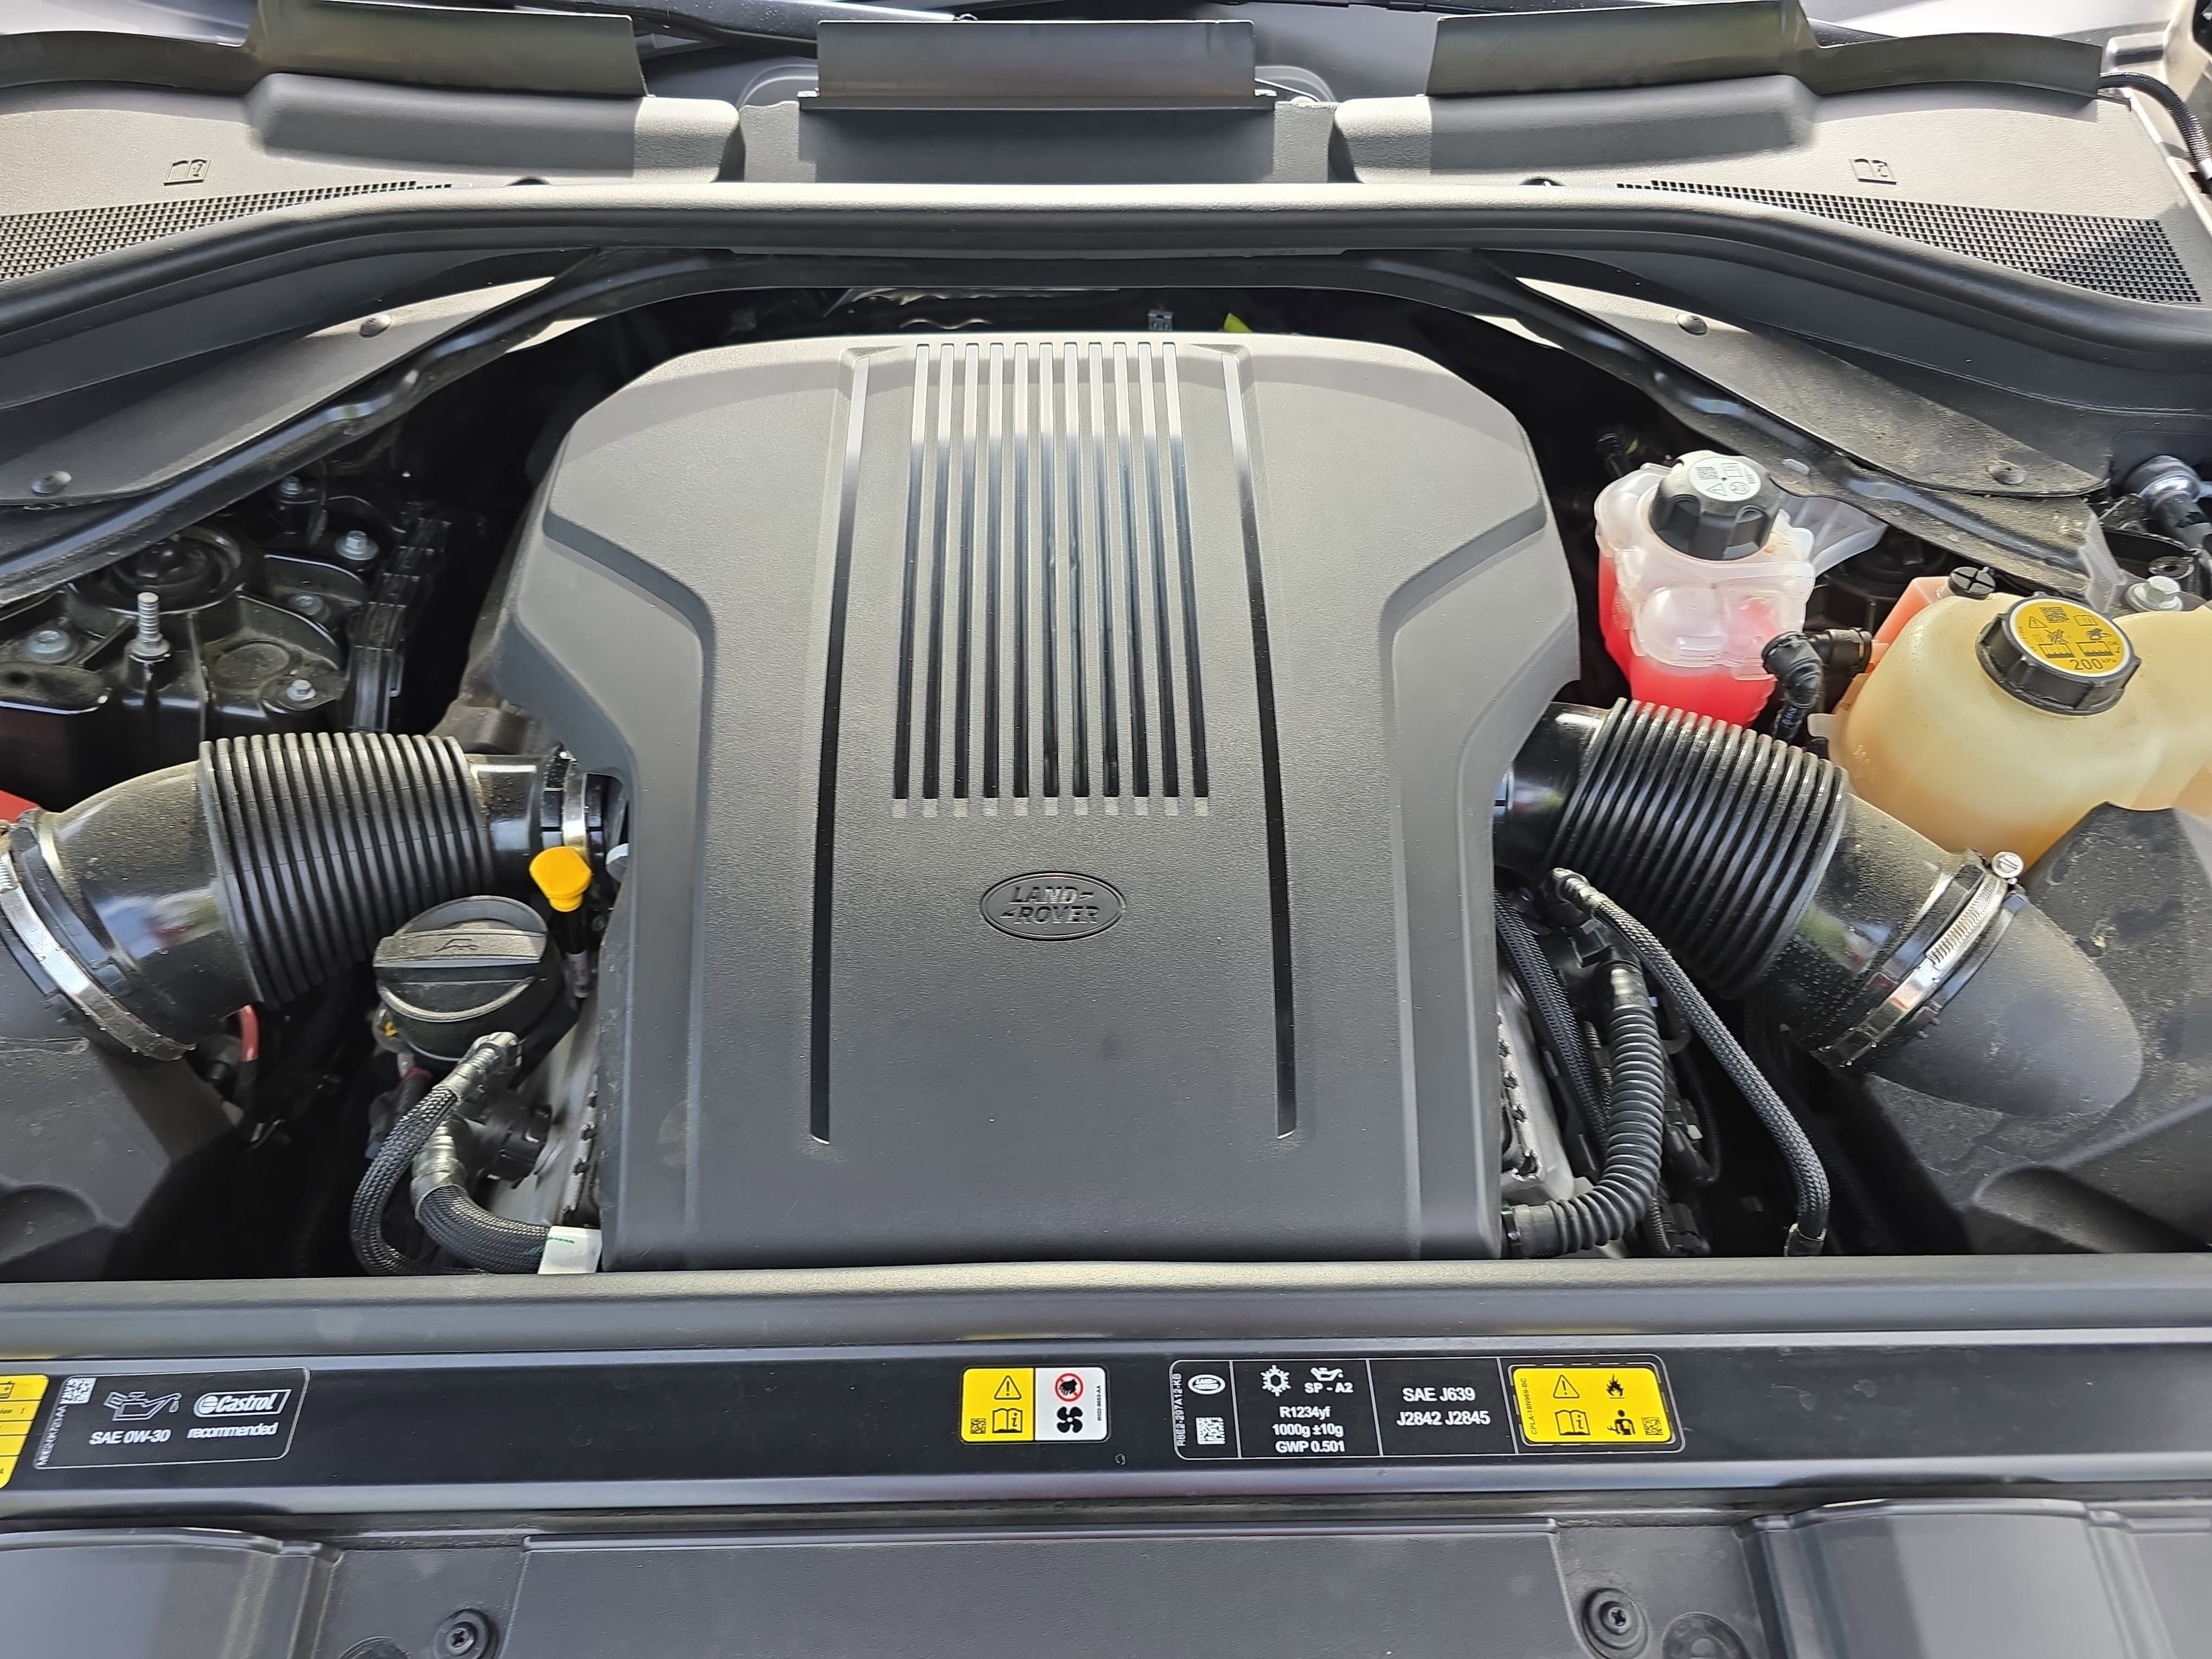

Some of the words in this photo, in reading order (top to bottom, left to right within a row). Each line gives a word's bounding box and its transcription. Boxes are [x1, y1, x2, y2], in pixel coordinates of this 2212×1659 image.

[2069, 658, 2103, 670] 200
[1304, 1382, 1323, 1393] SP
[1334, 1382, 1354, 1393] A2
[1402, 1387, 1438, 1402] SAE
[1439, 1386, 1476, 1401] J639
[215, 1392, 279, 1413] Castrol
[1279, 1405, 1331, 1420] R1234yf
[1396, 1411, 1443, 1426] J2842
[1444, 1410, 1491, 1425] J2845
[89, 1430, 125, 1445] SAE
[123, 1429, 171, 1444] 0W-30
[187, 1422, 279, 1439] recommended
[1272, 1423, 1311, 1438] 1000g
[1311, 1423, 1344, 1438] ±10g
[1275, 1440, 1309, 1453] GWP
[1310, 1440, 1346, 1453] 0.501
